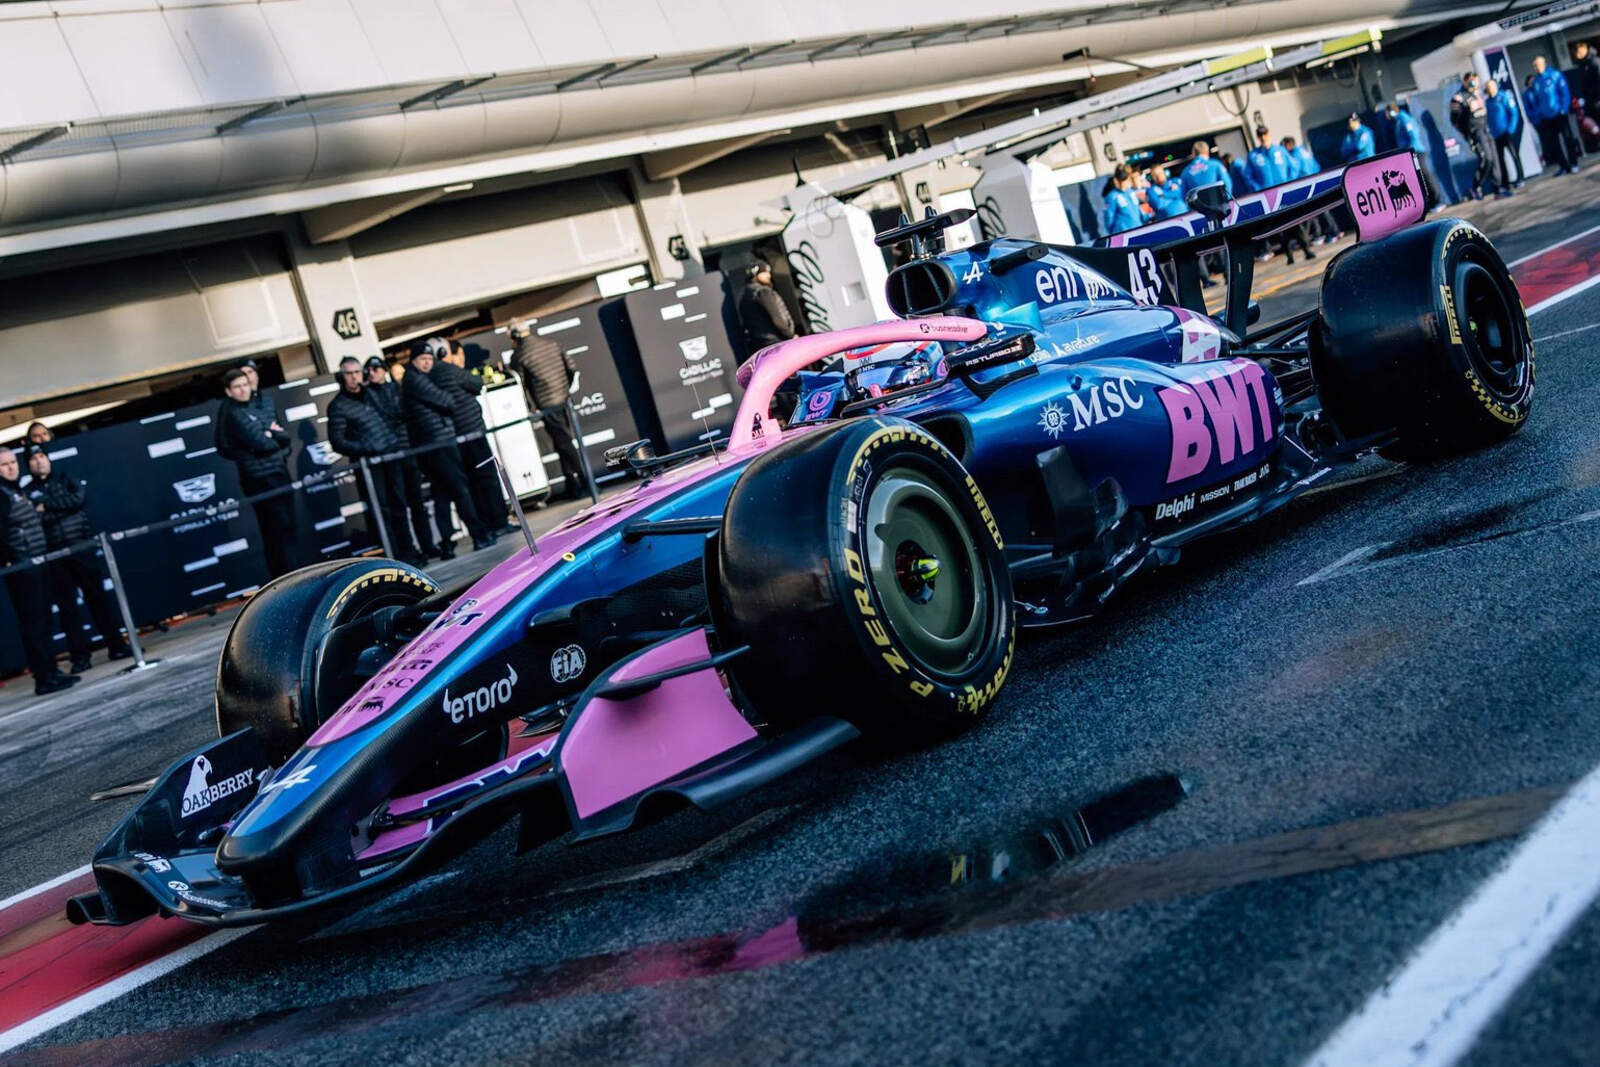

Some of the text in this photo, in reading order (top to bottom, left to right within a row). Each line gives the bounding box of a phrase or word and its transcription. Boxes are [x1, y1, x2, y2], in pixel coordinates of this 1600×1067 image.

[1356, 176, 1387, 216] eni
[1035, 265, 1078, 303] eni
[1127, 248, 1162, 306] 43
[338, 311, 358, 336] 46
[1066, 375, 1144, 432] MSC
[1158, 358, 1274, 484] BWT
[1155, 485, 1230, 520] Delphi MISSION
[843, 547, 935, 697] P ZERO
[182, 767, 254, 815] OAKBERRY
